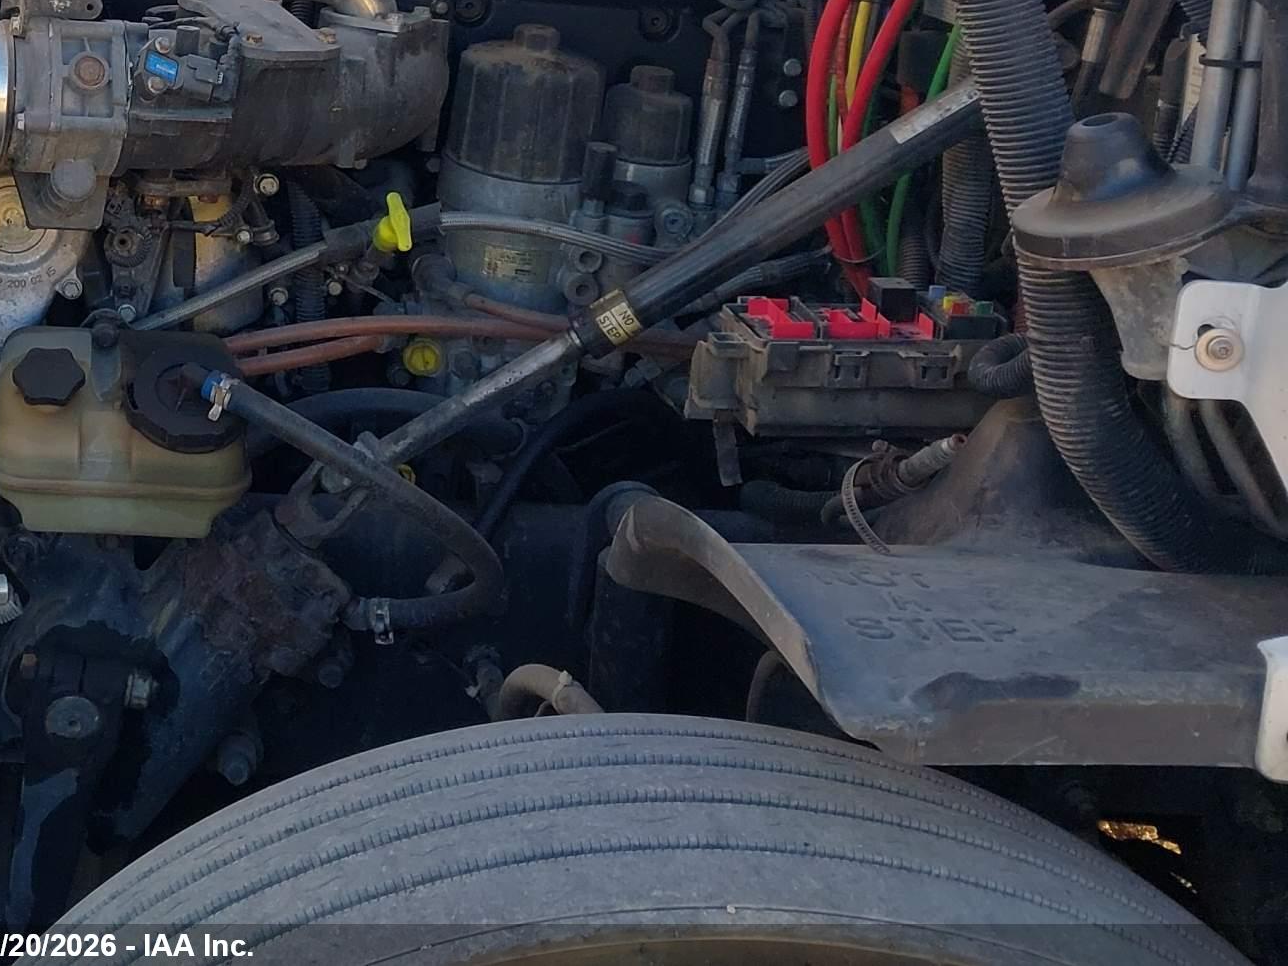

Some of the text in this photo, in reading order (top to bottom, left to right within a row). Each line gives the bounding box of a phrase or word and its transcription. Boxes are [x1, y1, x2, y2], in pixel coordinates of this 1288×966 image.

[7, 278, 27, 289] 200
[599, 315, 621, 339] STEP
[618, 310, 635, 326] NO
[845, 617, 1017, 642] STEP
